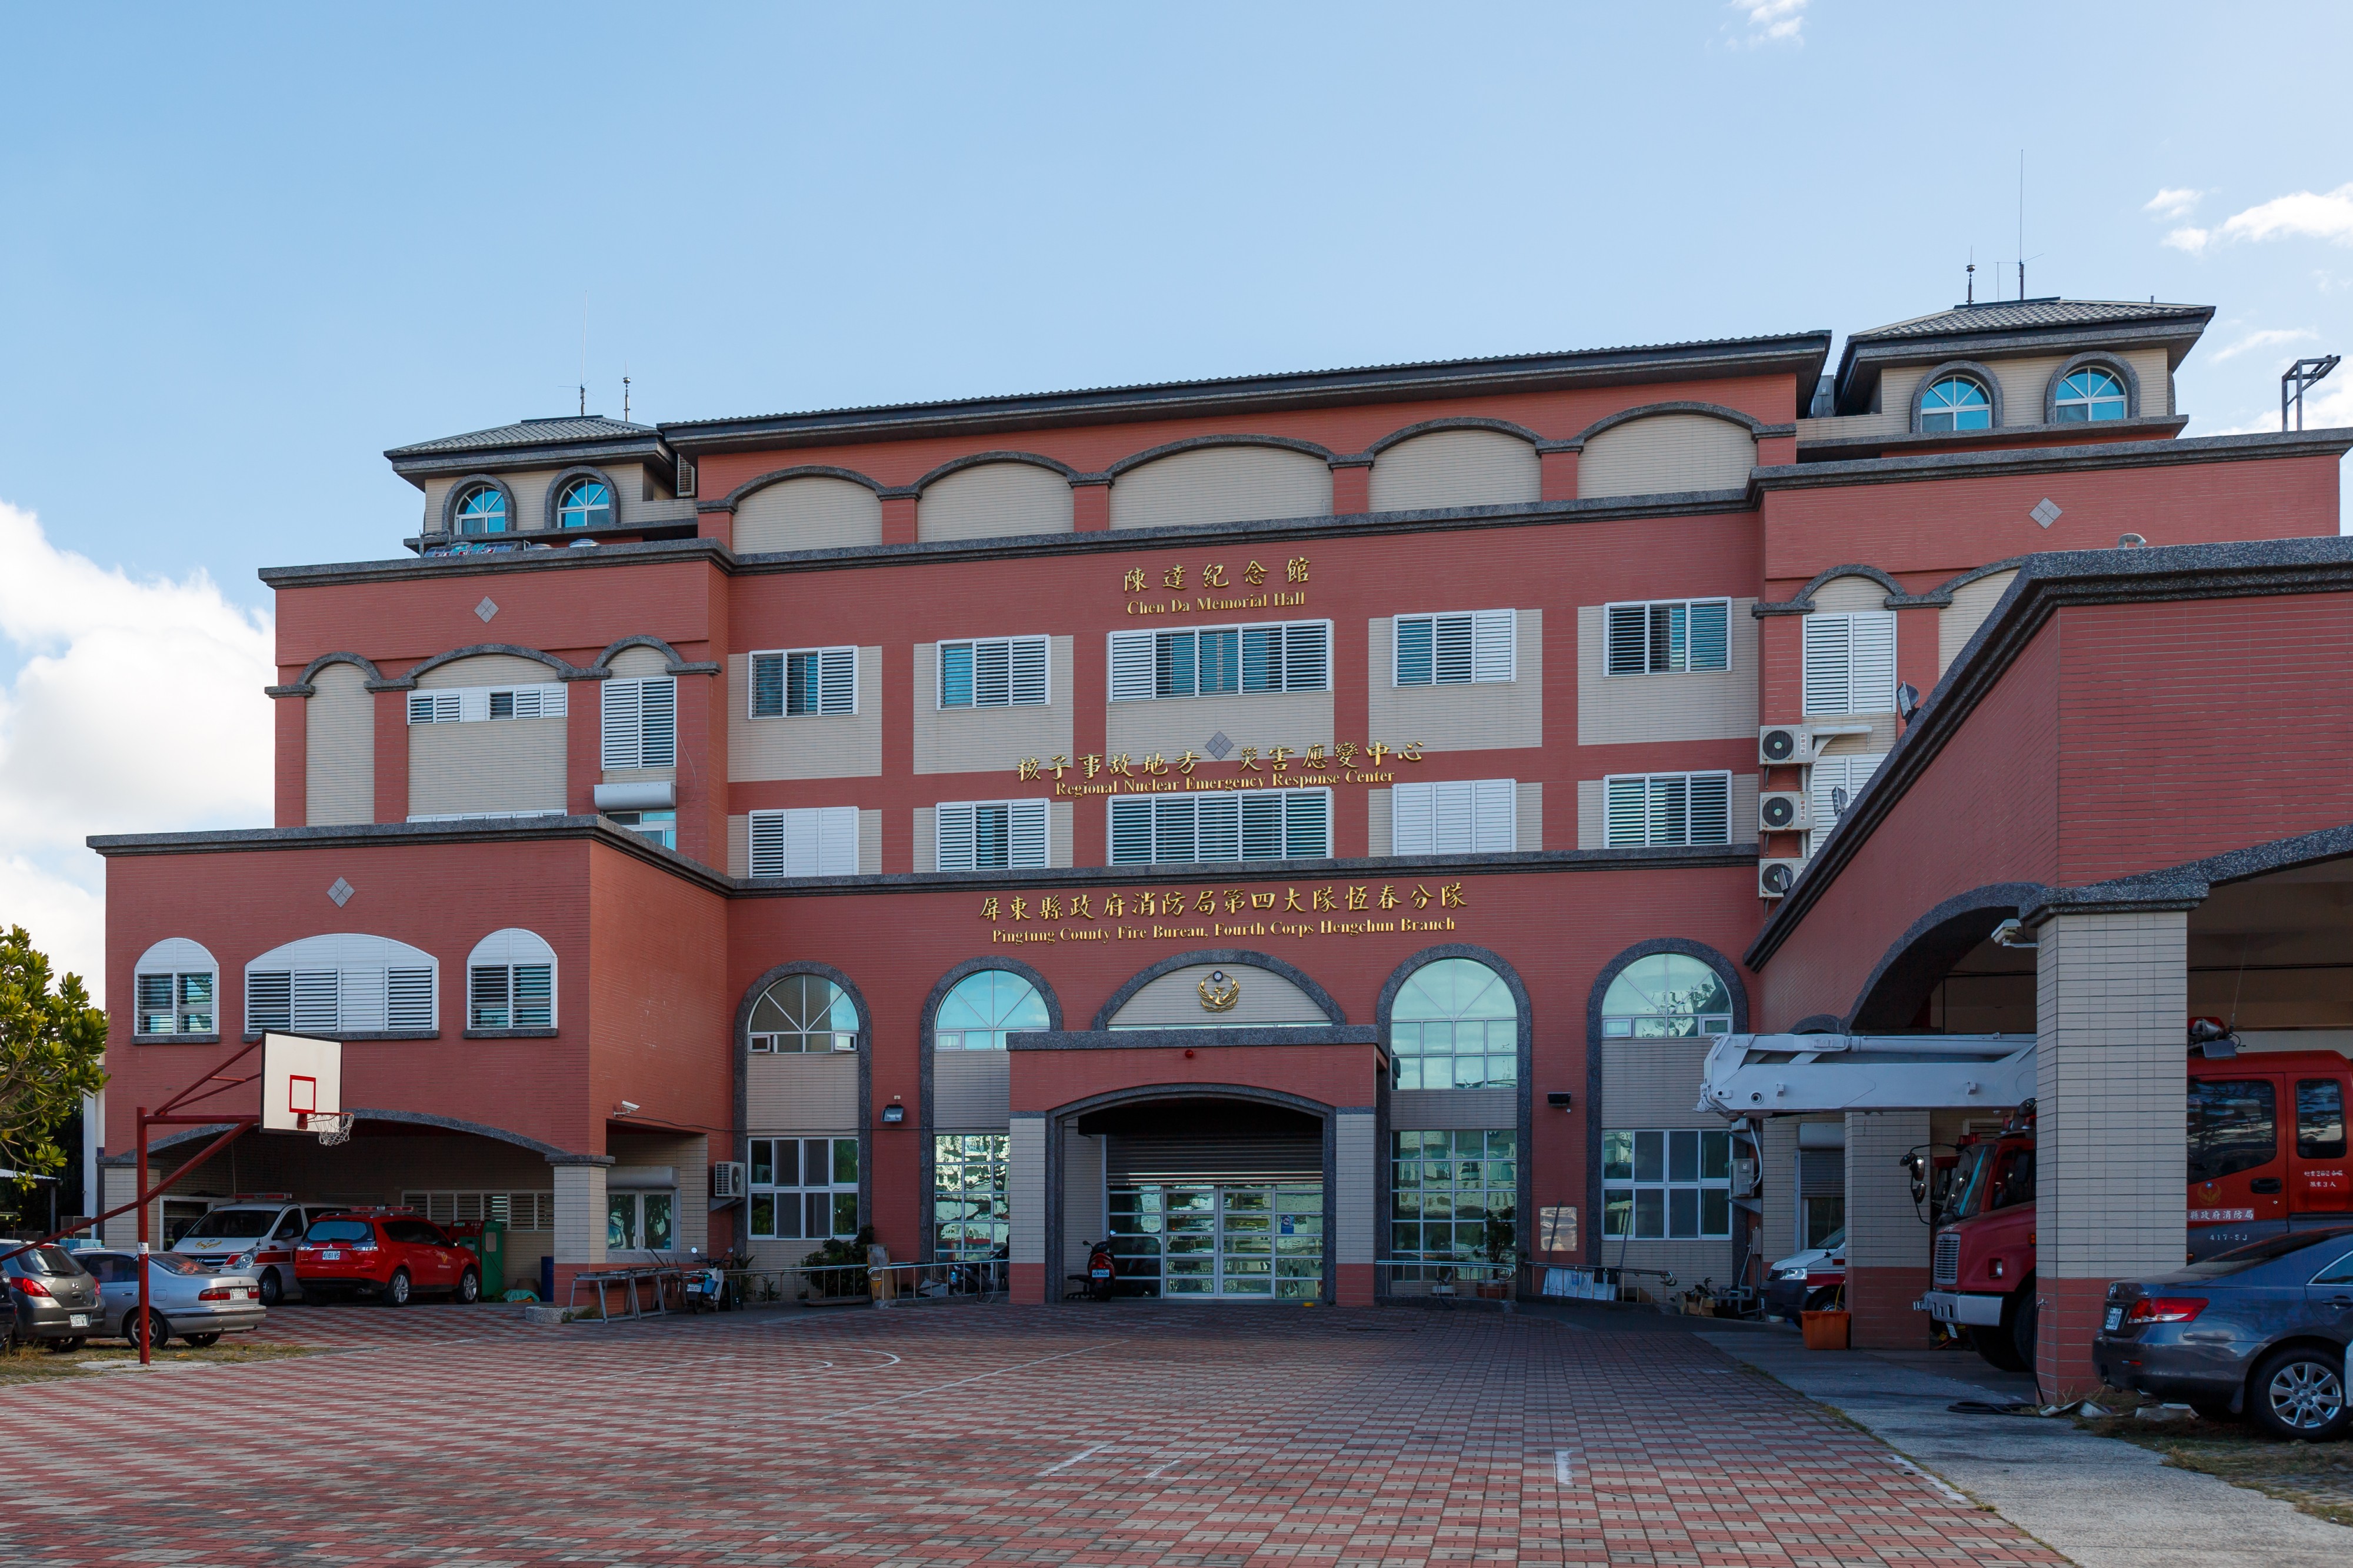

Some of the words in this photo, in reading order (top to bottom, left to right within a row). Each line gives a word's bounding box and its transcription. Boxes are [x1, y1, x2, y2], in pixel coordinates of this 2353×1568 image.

[1124, 556, 1311, 592] 陳達紀念館
[1127, 601, 1165, 615] Chen
[1171, 599, 1190, 612] Da
[1197, 593, 1268, 611] Memorial
[1273, 592, 1305, 606] Hall
[1055, 780, 1118, 798] Regional
[1124, 778, 1179, 793] Nuclear
[1185, 776, 1266, 791] Emergency
[1272, 773, 1340, 789] Response
[1345, 770, 1395, 784] Center
[992, 929, 1055, 945] Pingtung
[1059, 926, 1111, 944] County
[1117, 926, 1147, 939] Fire
[1152, 925, 1209, 940] Bureau,
[1214, 922, 1265, 937] Fourth
[1270, 921, 1314, 939] Corps
[1320, 918, 1394, 937] Hengchun
[1401, 916, 1455, 932] Branch
[2188, 1210, 2254, 1220] 縣政府消防局
